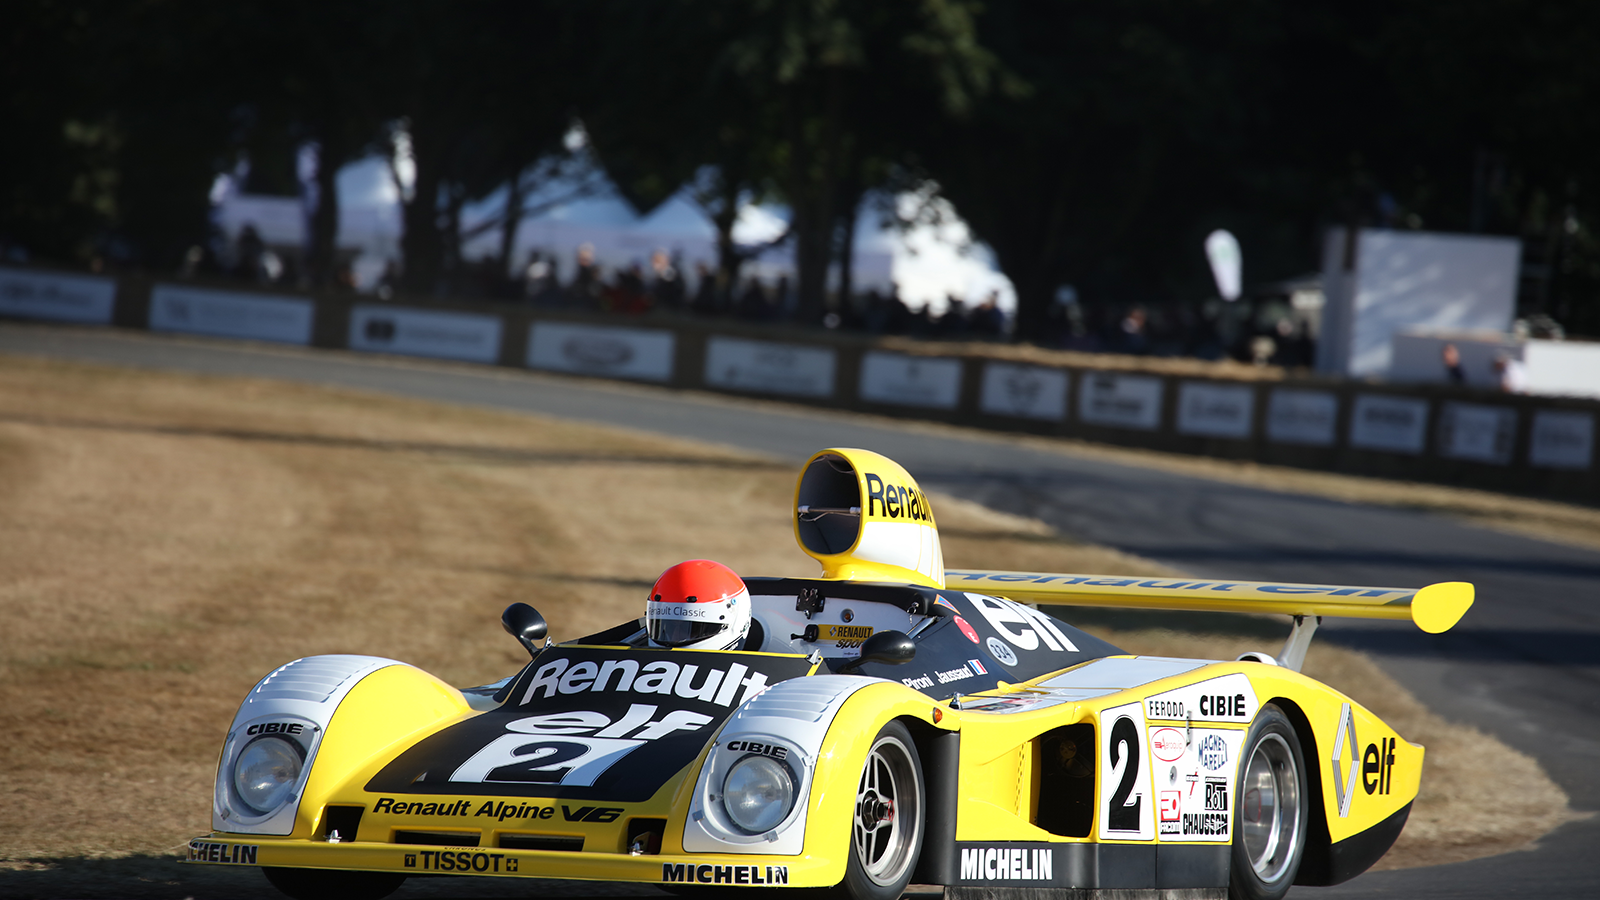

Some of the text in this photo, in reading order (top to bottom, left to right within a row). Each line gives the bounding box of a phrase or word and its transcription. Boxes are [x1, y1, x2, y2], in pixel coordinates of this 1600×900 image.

[673, 606, 706, 618] Classic
[963, 592, 1080, 652] elf
[835, 639, 863, 649] spor
[837, 626, 873, 638] RENAULT
[518, 657, 769, 708] Renault
[901, 663, 974, 690] Pironi Jaussaud
[504, 703, 714, 740] elf
[1149, 701, 1184, 717] FERODO
[482, 741, 592, 784] 2
[1107, 714, 1143, 833] 2
[1362, 737, 1396, 795] elf
[372, 797, 625, 824] Renault Alpine V6
[1182, 813, 1229, 835] CHAUSSON
[420, 851, 505, 872] TISSOT
[662, 863, 788, 885] MICHELIN
[960, 847, 1053, 881] MICHELIN
